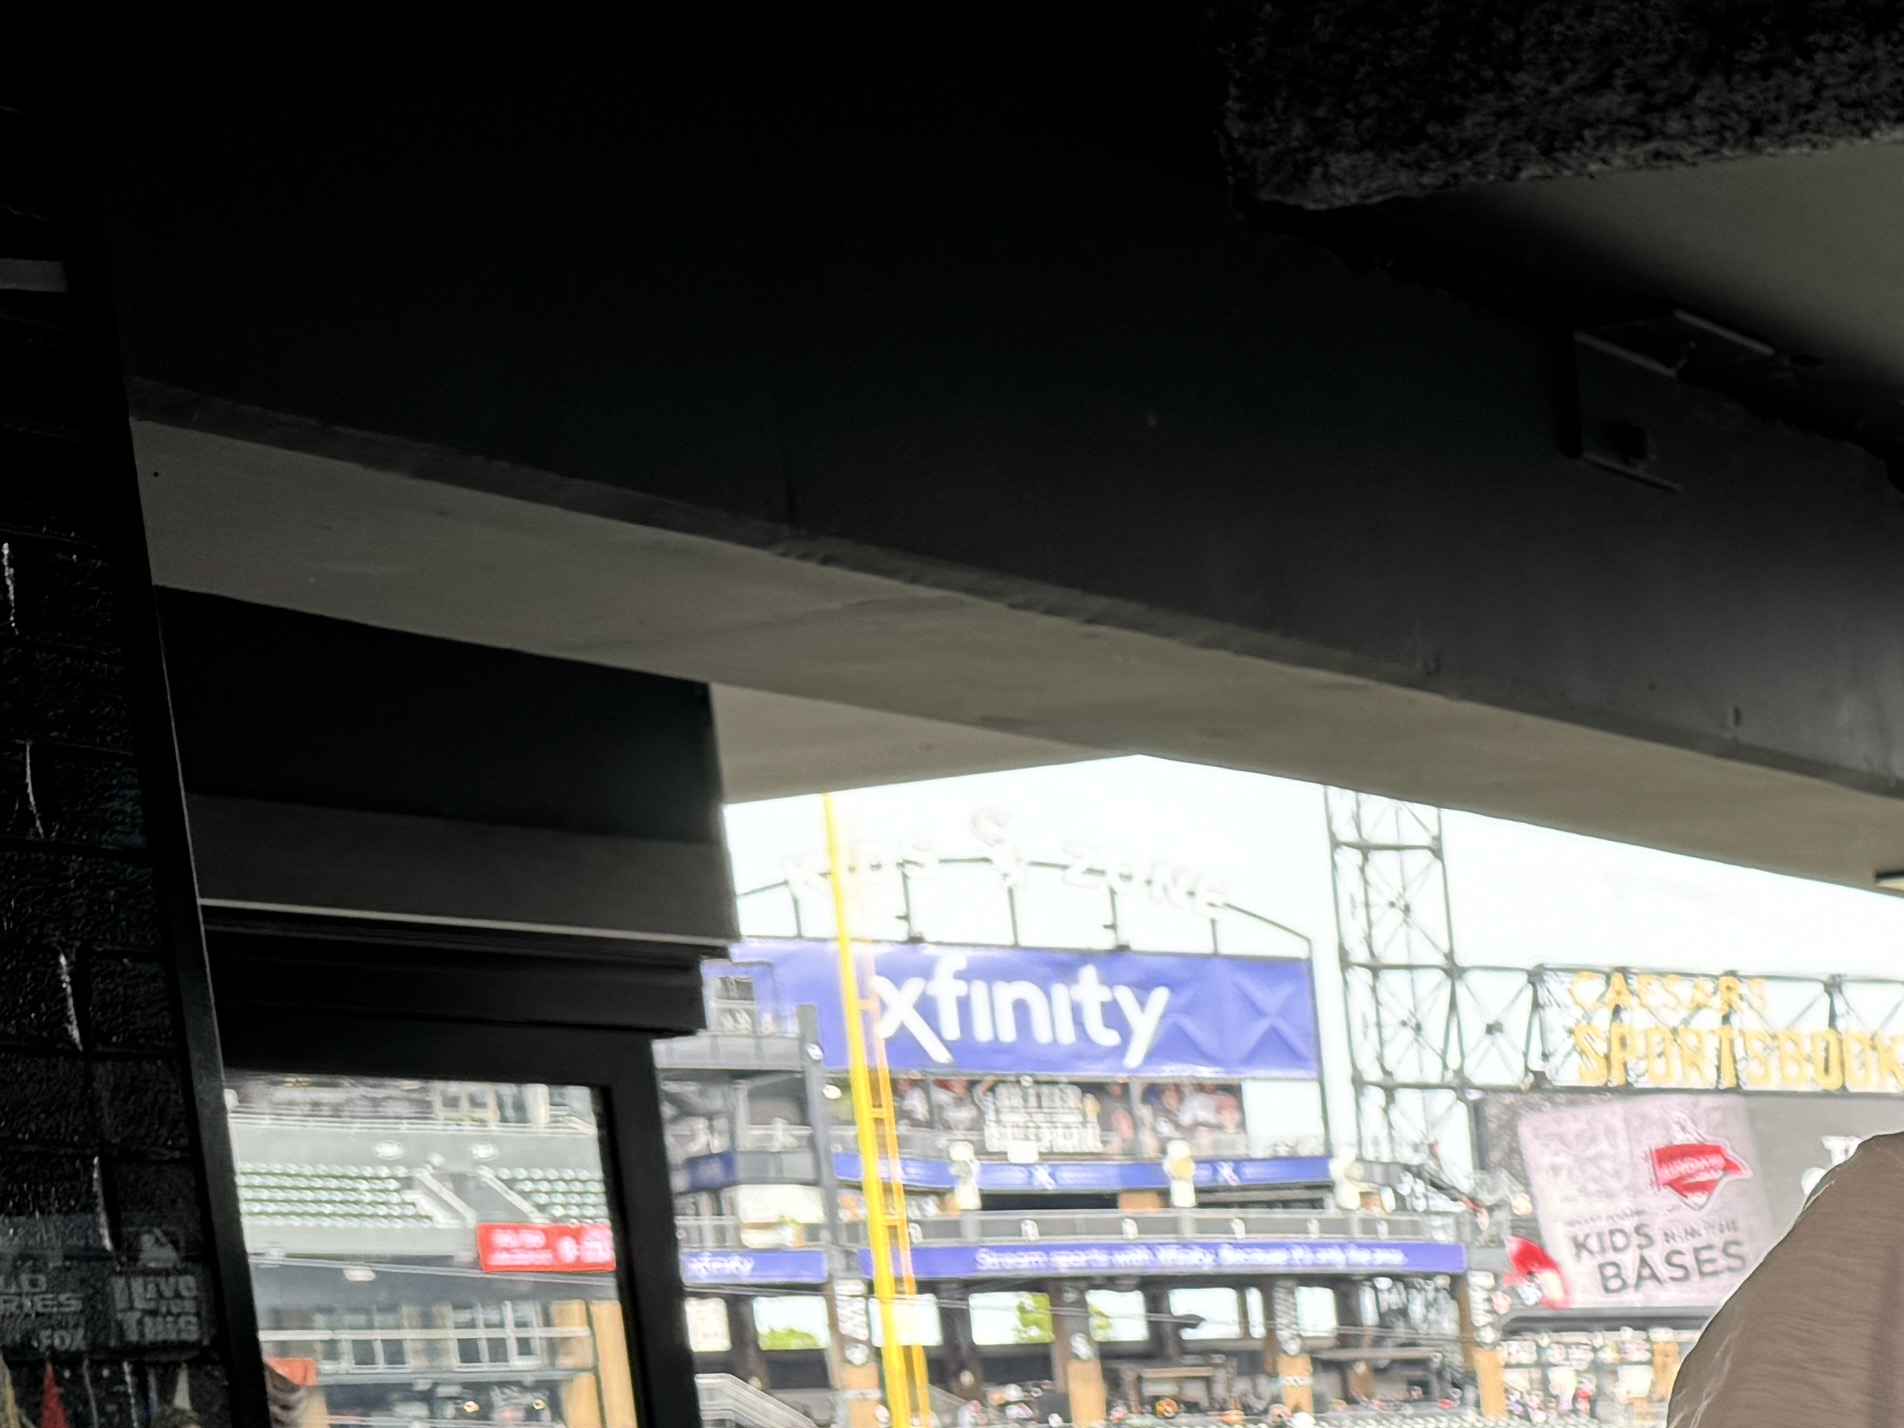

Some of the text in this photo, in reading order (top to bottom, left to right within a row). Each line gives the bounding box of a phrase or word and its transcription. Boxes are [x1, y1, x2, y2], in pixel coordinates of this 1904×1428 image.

[869, 952, 1171, 1069] xfinity
[1571, 971, 1767, 1014] CAESARS
[1571, 1223, 1655, 1261] KIDS
[1598, 1239, 1747, 1294] BASES
